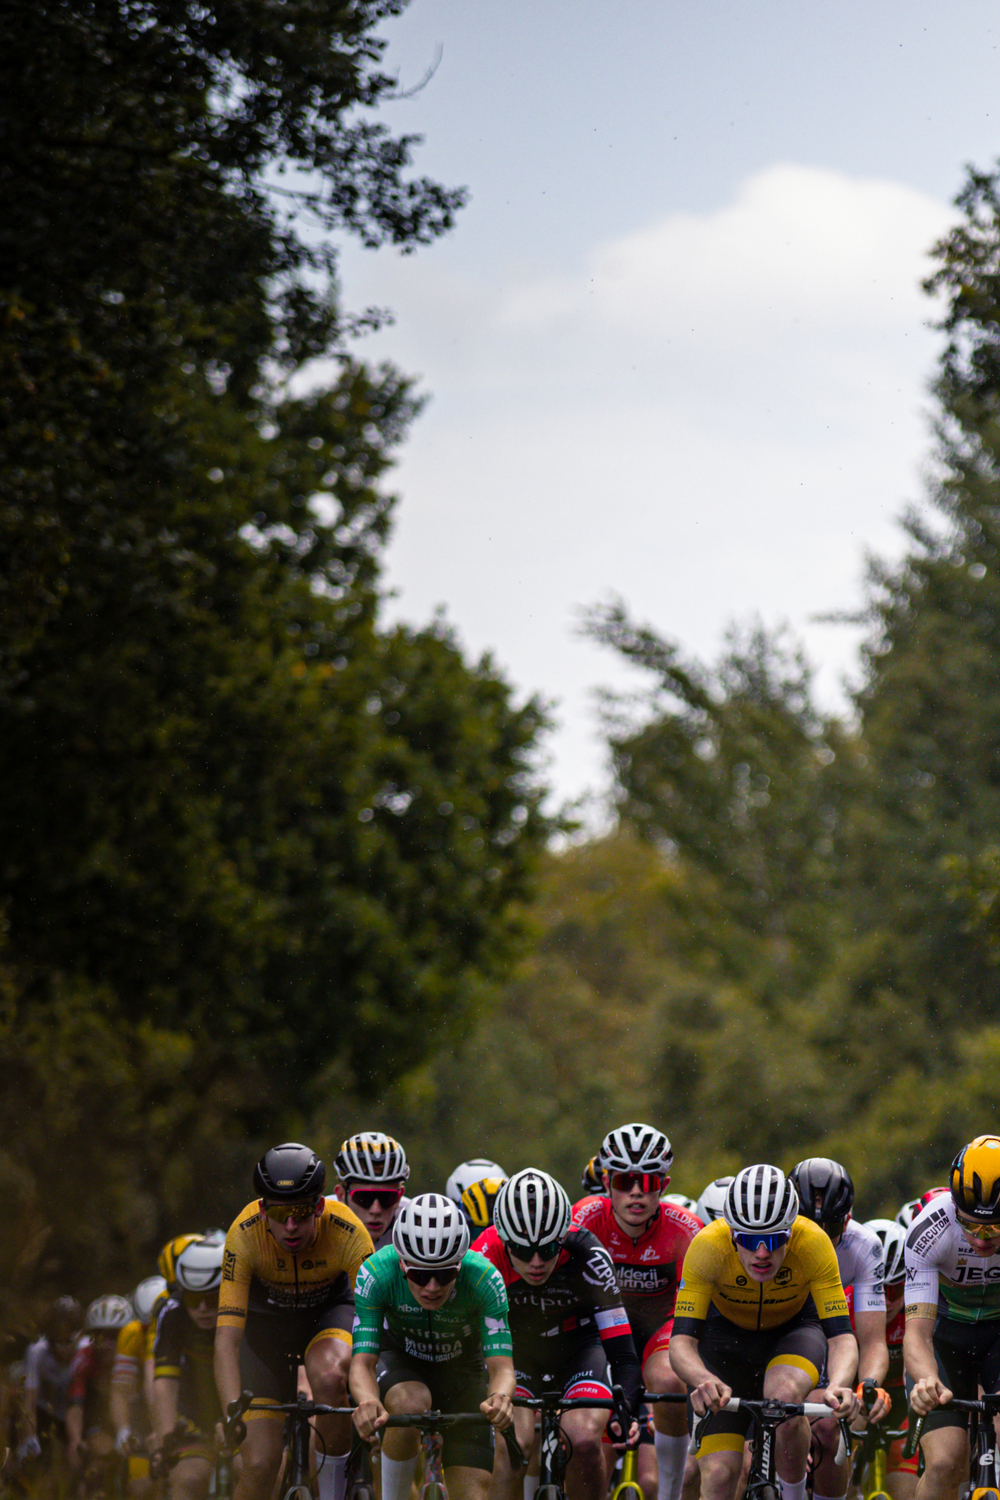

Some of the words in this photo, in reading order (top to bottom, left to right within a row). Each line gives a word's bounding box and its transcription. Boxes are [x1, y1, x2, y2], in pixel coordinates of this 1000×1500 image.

[913, 1216, 950, 1255] HERCUTON
[508, 1294, 582, 1311] utput
[761, 1430, 772, 1480] GIANT
